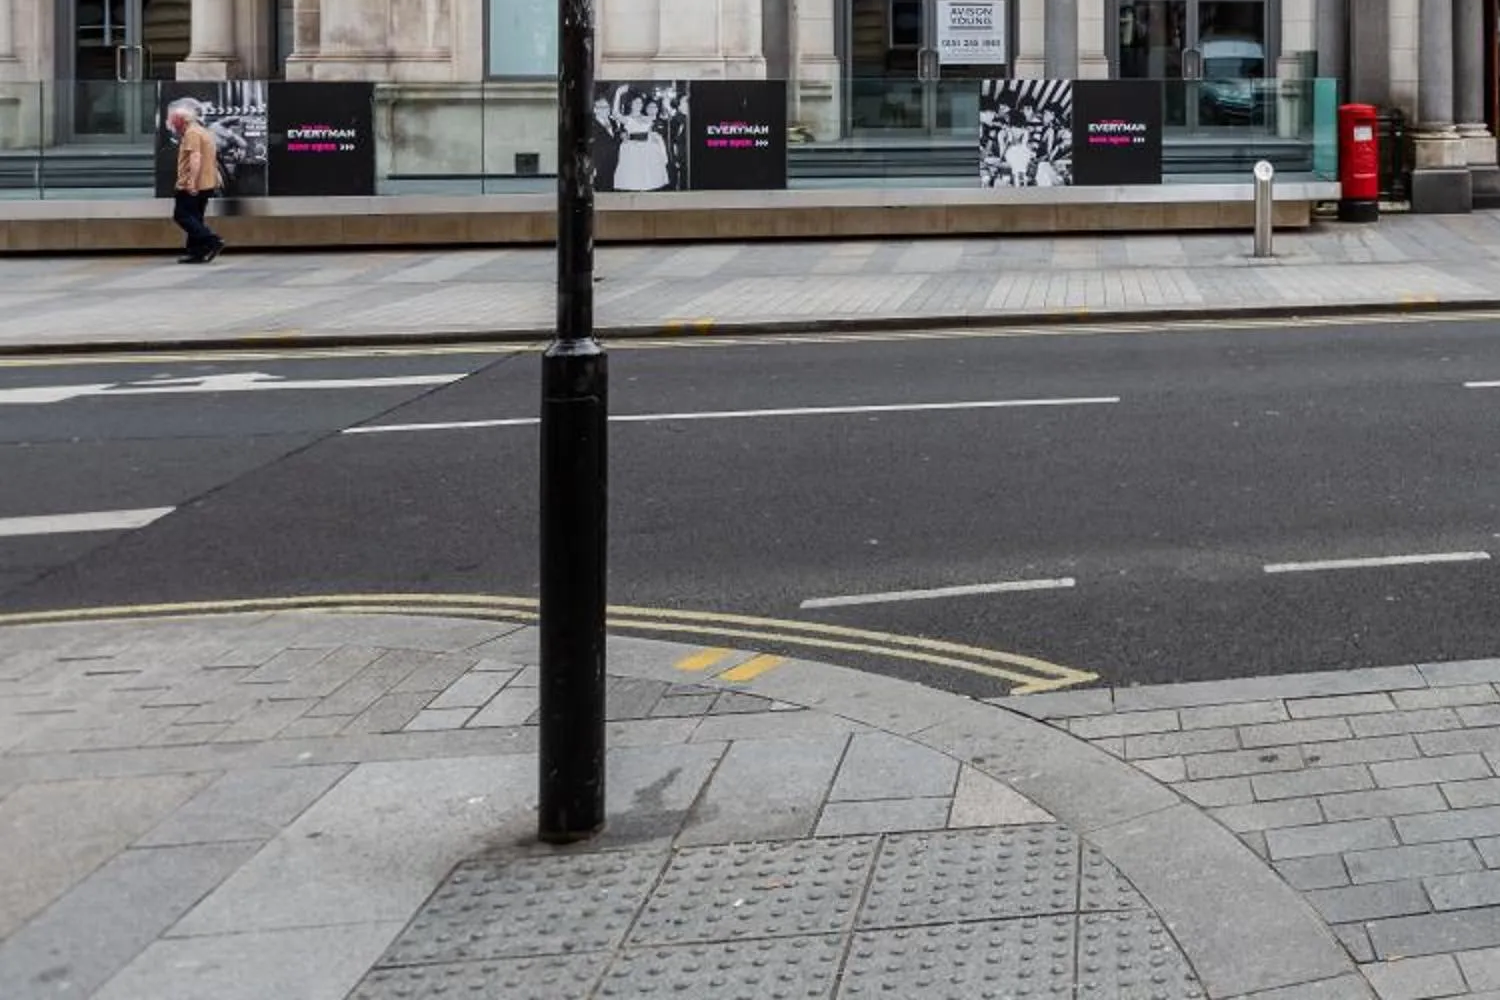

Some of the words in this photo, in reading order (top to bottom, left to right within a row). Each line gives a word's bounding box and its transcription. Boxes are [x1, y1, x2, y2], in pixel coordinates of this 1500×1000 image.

[951, 7, 993, 17] AVISON
[951, 17, 993, 25] YOUNG
[707, 125, 769, 135] EVERYMAN
[1088, 123, 1147, 133] EVERYMAN
[287, 129, 356, 139] EVERYMAN
